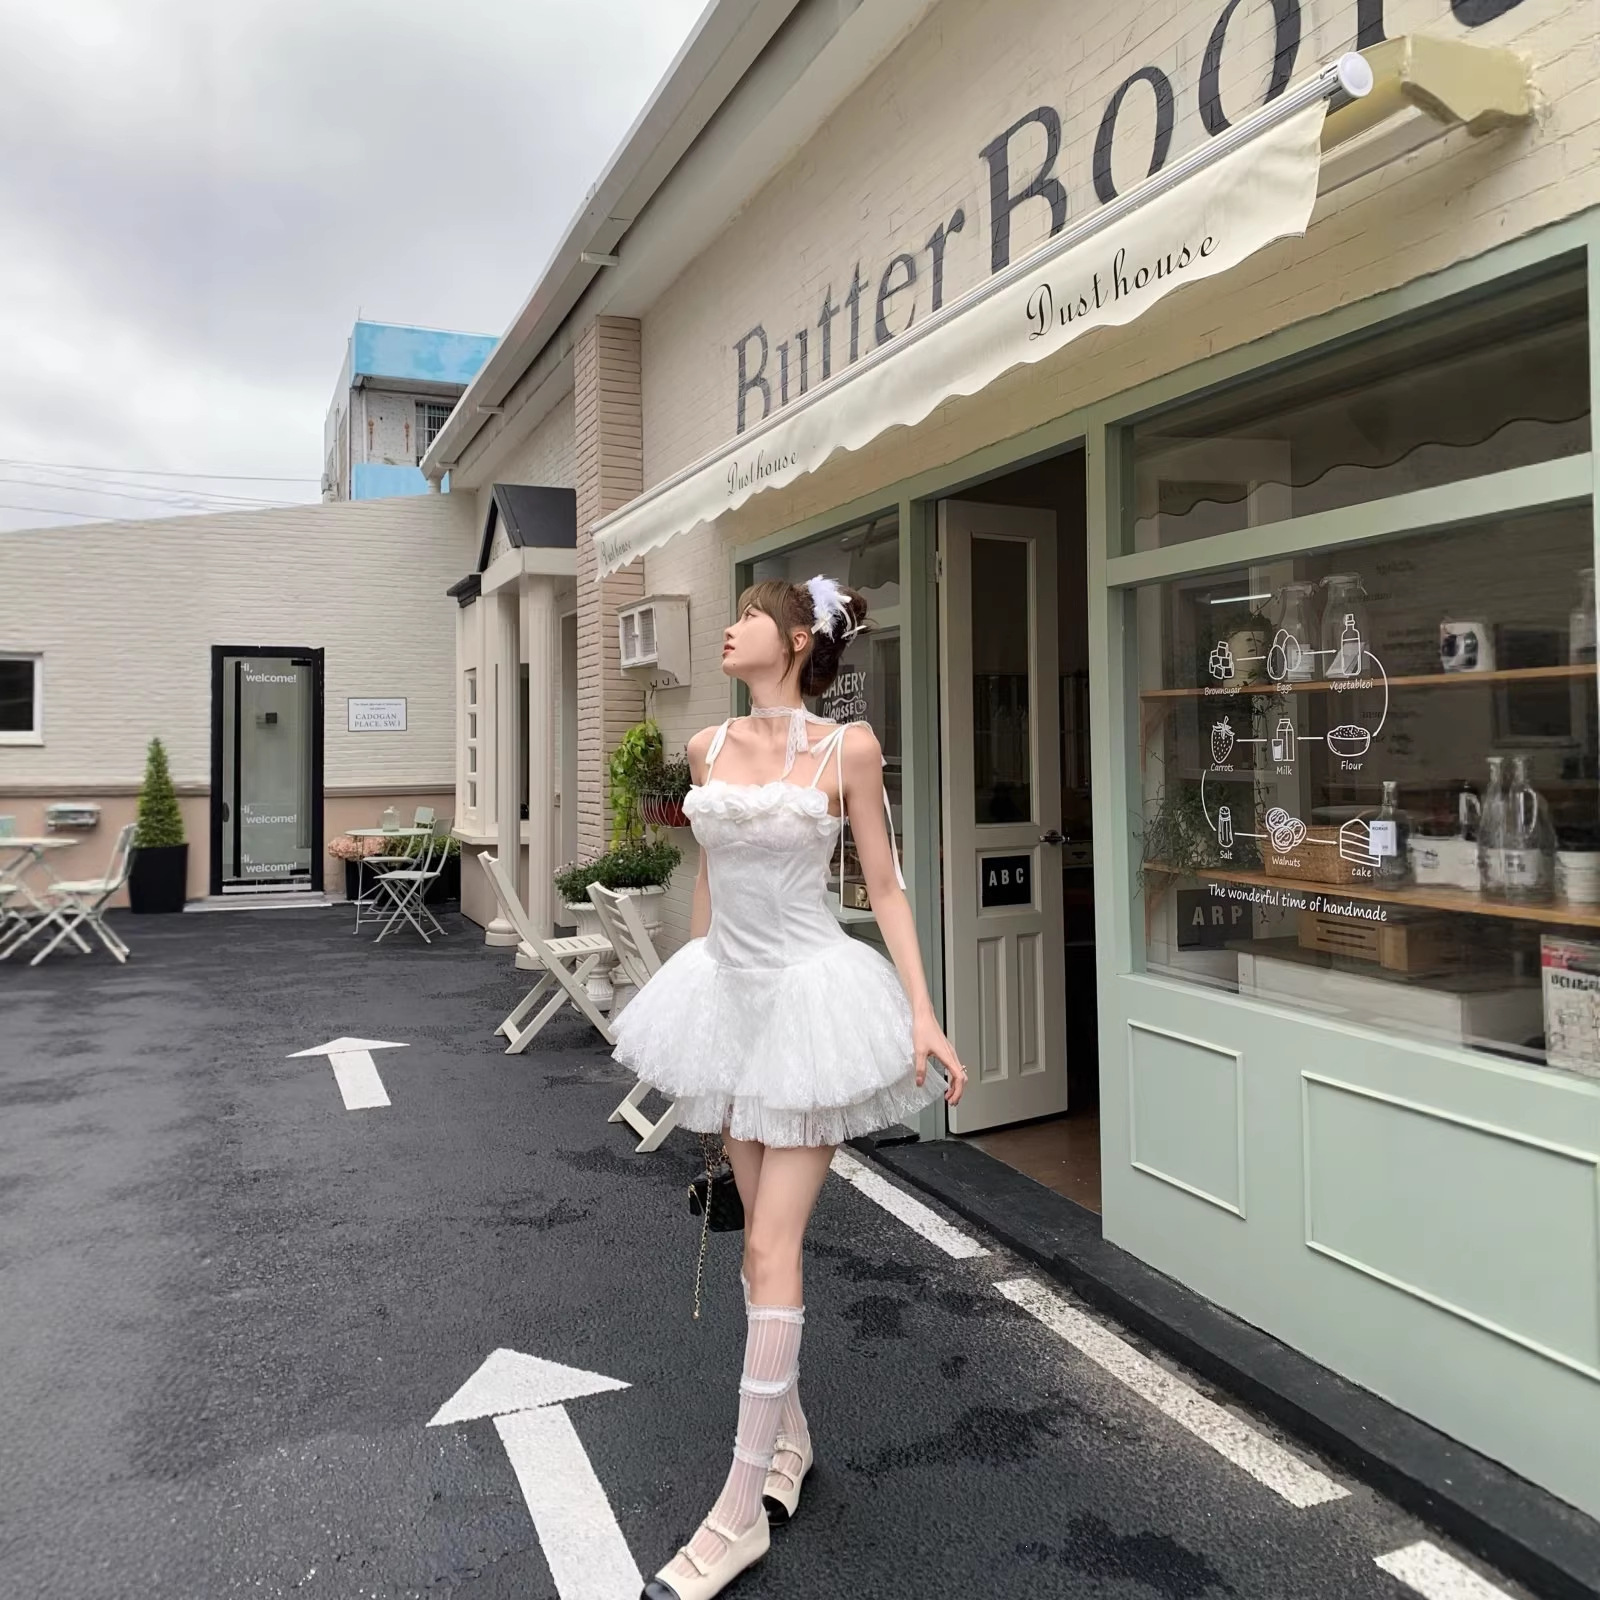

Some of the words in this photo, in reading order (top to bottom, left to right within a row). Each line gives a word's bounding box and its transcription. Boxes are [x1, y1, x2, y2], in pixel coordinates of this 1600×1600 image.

[1026, 236, 1221, 341] Dusthouse
[727, 449, 799, 496] Dusthouse
[245, 672, 297, 683] welcome!
[1204, 687, 1242, 697] Brownsugar
[1276, 683, 1293, 695] Eggs
[1210, 763, 1234, 773] Carrots
[1275, 766, 1293, 776] Milk
[1340, 760, 1364, 771] Flour
[246, 813, 297, 824] welcome!
[1219, 850, 1233, 860] Salt
[1271, 855, 1301, 868] Walnuts
[1351, 866, 1372, 878] cake
[1208, 884, 1225, 897] The
[1227, 888, 1280, 906] wonderful
[1281, 893, 1307, 910] time
[1309, 896, 1320, 912] of
[1322, 898, 1388, 922] handmade
